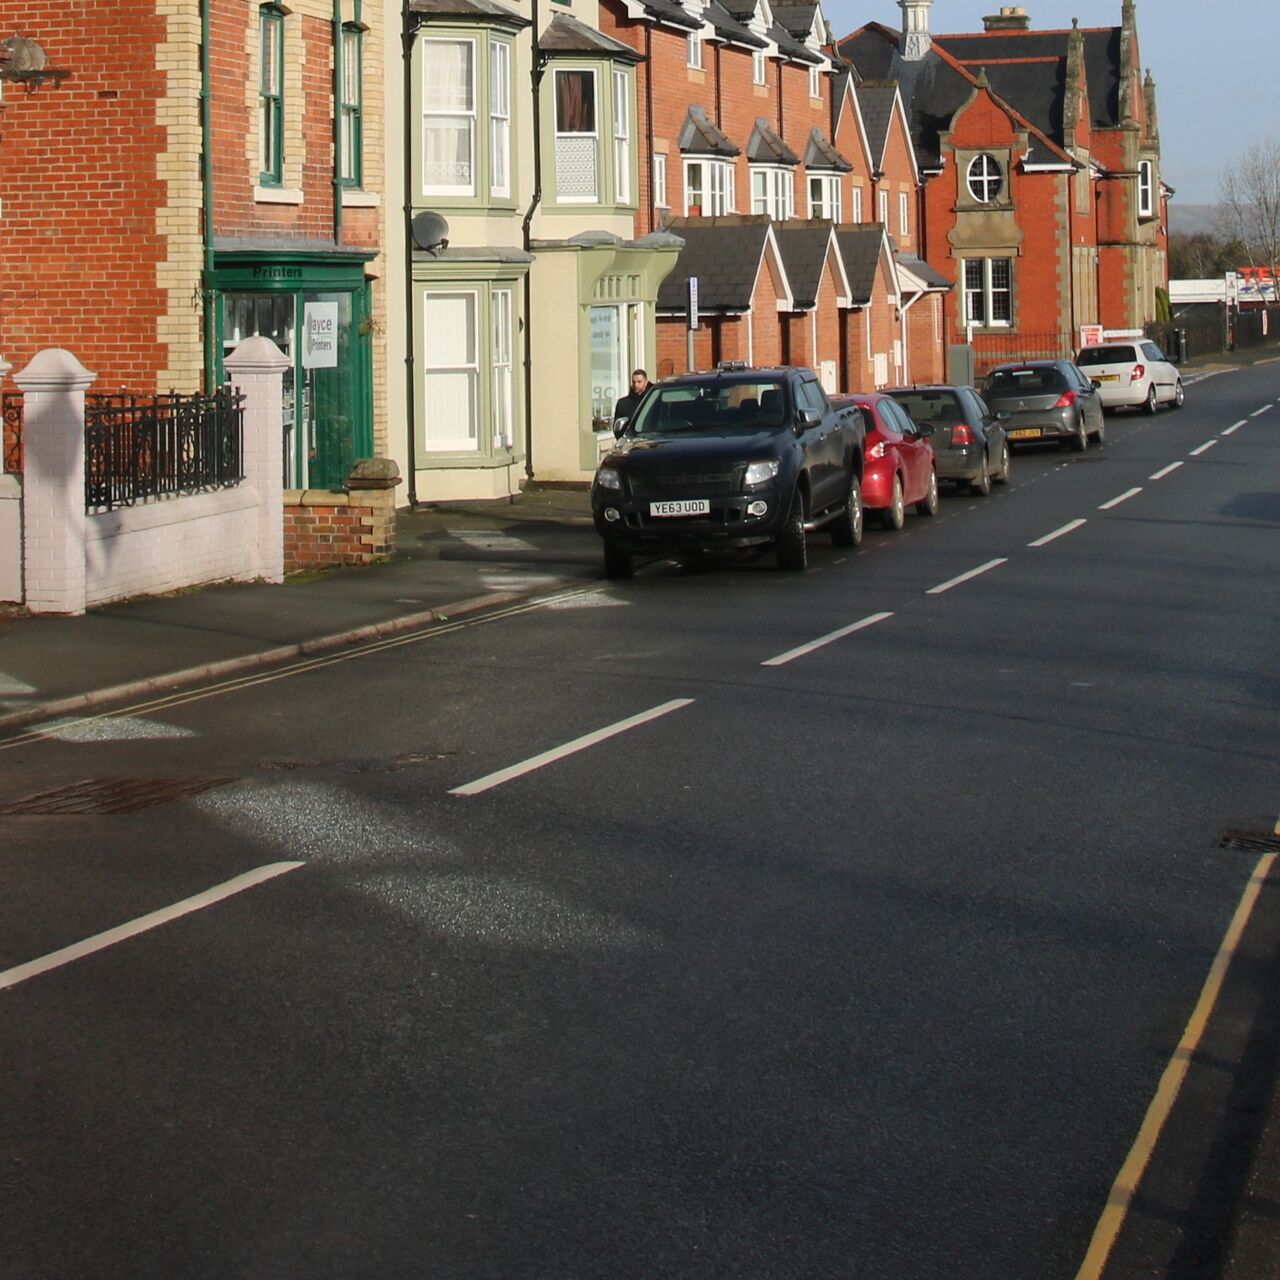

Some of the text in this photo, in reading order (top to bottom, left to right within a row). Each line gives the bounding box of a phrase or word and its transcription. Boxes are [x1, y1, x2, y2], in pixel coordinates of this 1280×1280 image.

[252, 267, 303, 278] Printers
[654, 501, 705, 514] YE63 UOD
